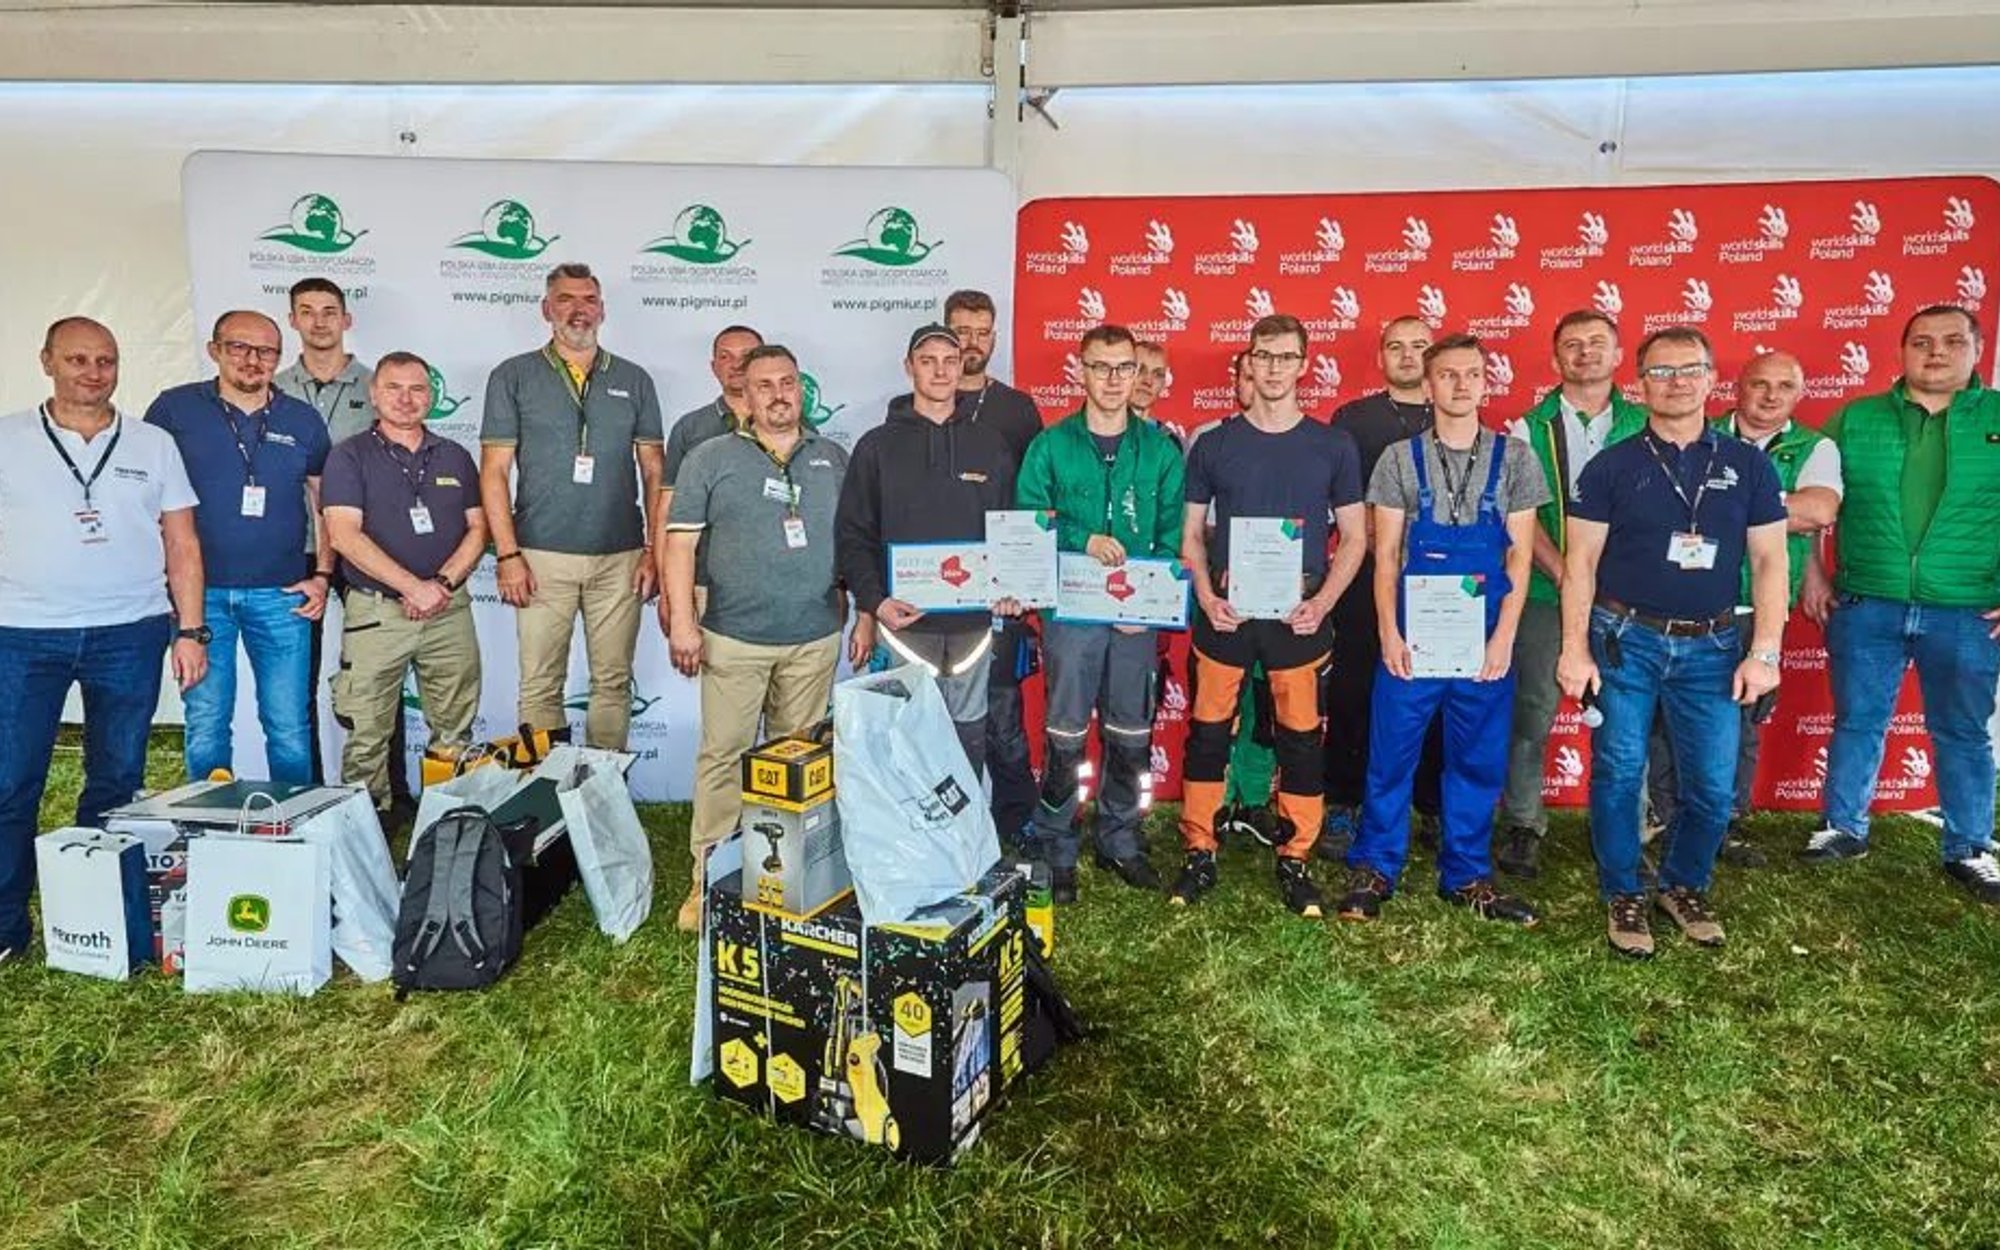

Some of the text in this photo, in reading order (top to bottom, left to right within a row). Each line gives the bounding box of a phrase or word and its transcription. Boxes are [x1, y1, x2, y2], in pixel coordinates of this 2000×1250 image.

[1811, 235, 1876, 248] worldskills
[1903, 231, 1969, 244] worldskills
[1630, 242, 1694, 254] worldskills
[1720, 238, 1784, 251] worldskills
[1903, 243, 1947, 256] Poland
[1026, 251, 1086, 264] worldskills
[1111, 252, 1170, 264] worldskills
[1195, 251, 1255, 264] worldskills
[1280, 251, 1340, 263] worldskills
[1365, 249, 1427, 262] worldskills
[1453, 248, 1515, 260] worldskills
[1541, 246, 1604, 258] worldskills
[1719, 251, 1763, 263] Poland
[1810, 247, 1854, 260] Poland
[1365, 261, 1407, 273] Poland
[1452, 259, 1494, 271] Poland
[1540, 257, 1583, 269] Poland
[1629, 254, 1673, 267] Poland
[1026, 262, 1066, 274] Poland
[1111, 264, 1151, 275] Poland
[1195, 263, 1236, 275] Poland
[1280, 262, 1321, 274] Poland
[452, 291, 543, 304] www.pigmiur.
[642, 295, 748, 310] www.pigmiur.pl
[832, 298, 937, 312] www.pigmiur.pl
[1824, 304, 1889, 317] worldskills
[1644, 310, 1708, 324] worldskills
[1734, 307, 1798, 321] worldskills
[1468, 316, 1531, 329] worldskills
[1733, 319, 1777, 332] Poland
[1823, 317, 1868, 329] Poland
[1193, 398, 1234, 410] Poland
[1783, 658, 1826, 670] Poland
[1797, 724, 1833, 736] Polan
[757, 767, 780, 787] CAT
[1775, 788, 1818, 801] Poland
[206, 936, 289, 950] JOHN DEERE
[900, 1000, 924, 1021] 40
